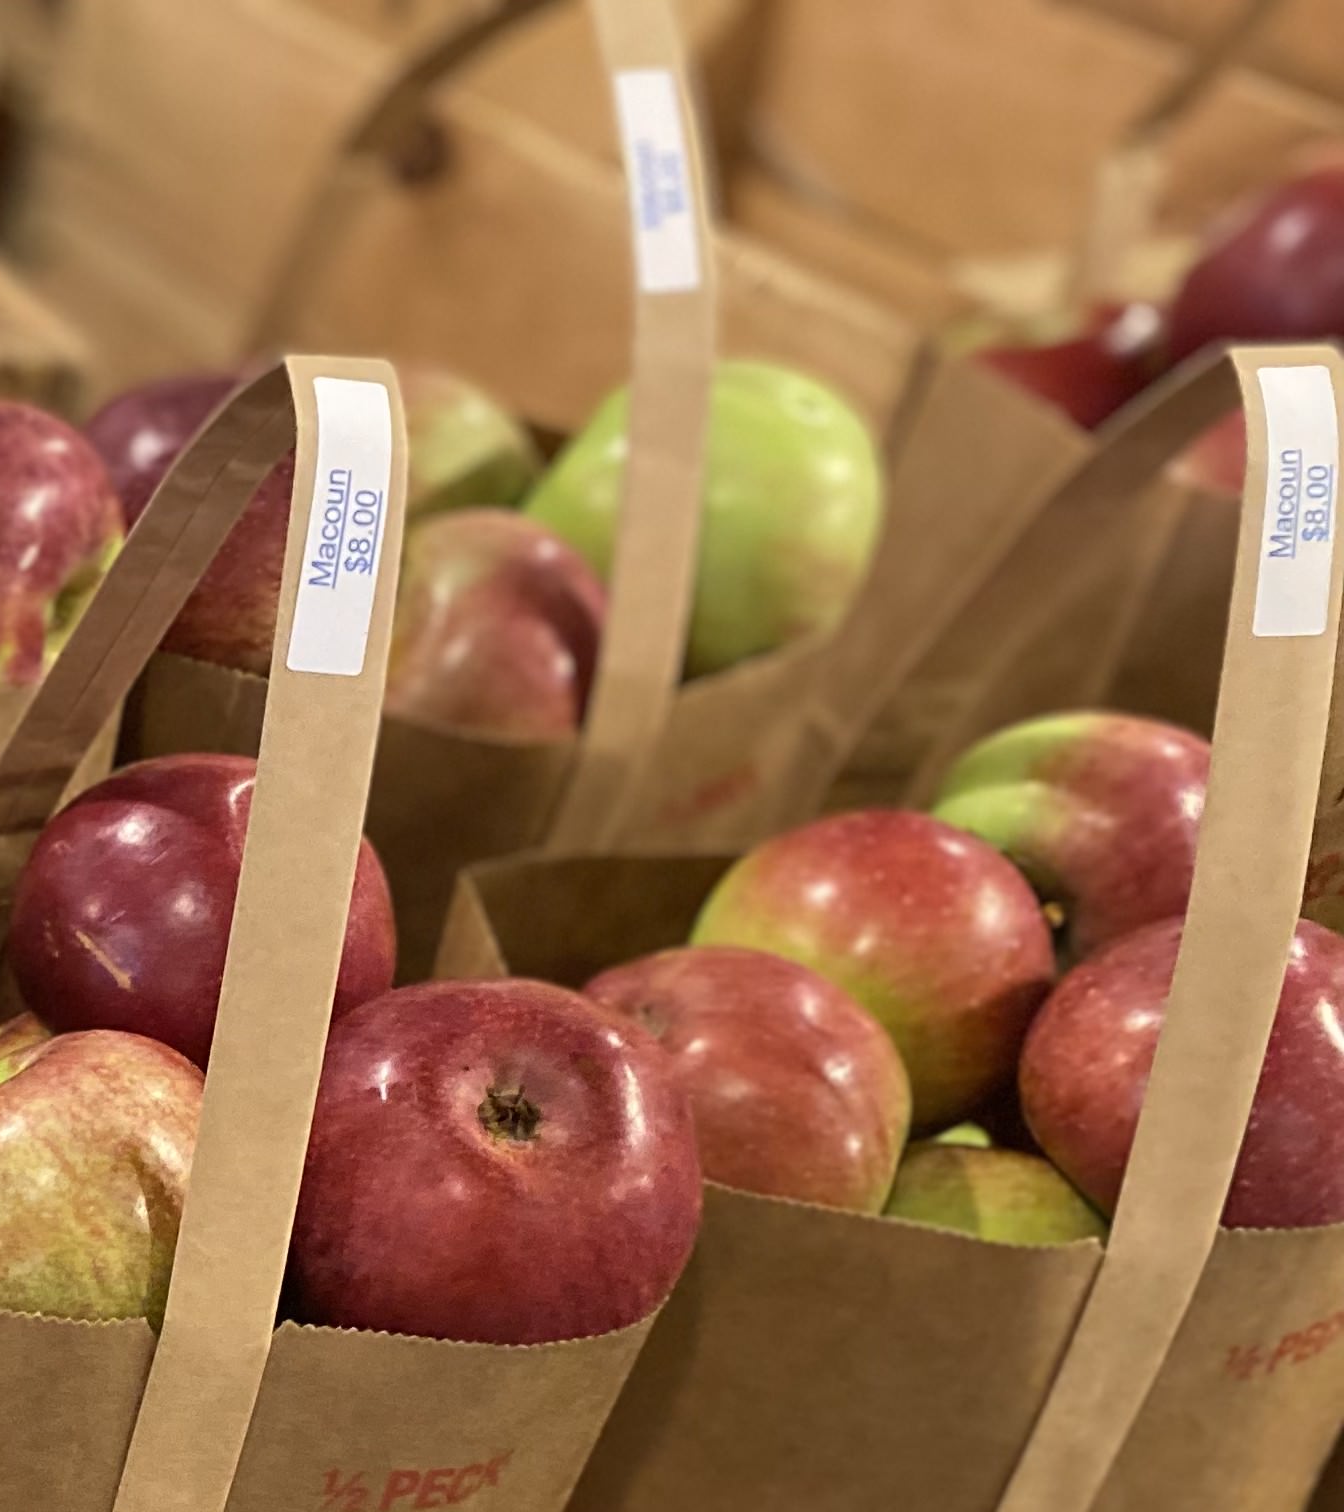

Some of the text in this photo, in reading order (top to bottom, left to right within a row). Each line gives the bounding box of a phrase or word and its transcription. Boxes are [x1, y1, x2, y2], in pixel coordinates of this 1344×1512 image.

[308, 468, 351, 588] Macoun
[344, 490, 383, 575] $8.00
[1267, 449, 1301, 558] Macoun
[1301, 464, 1333, 542] $8.00
